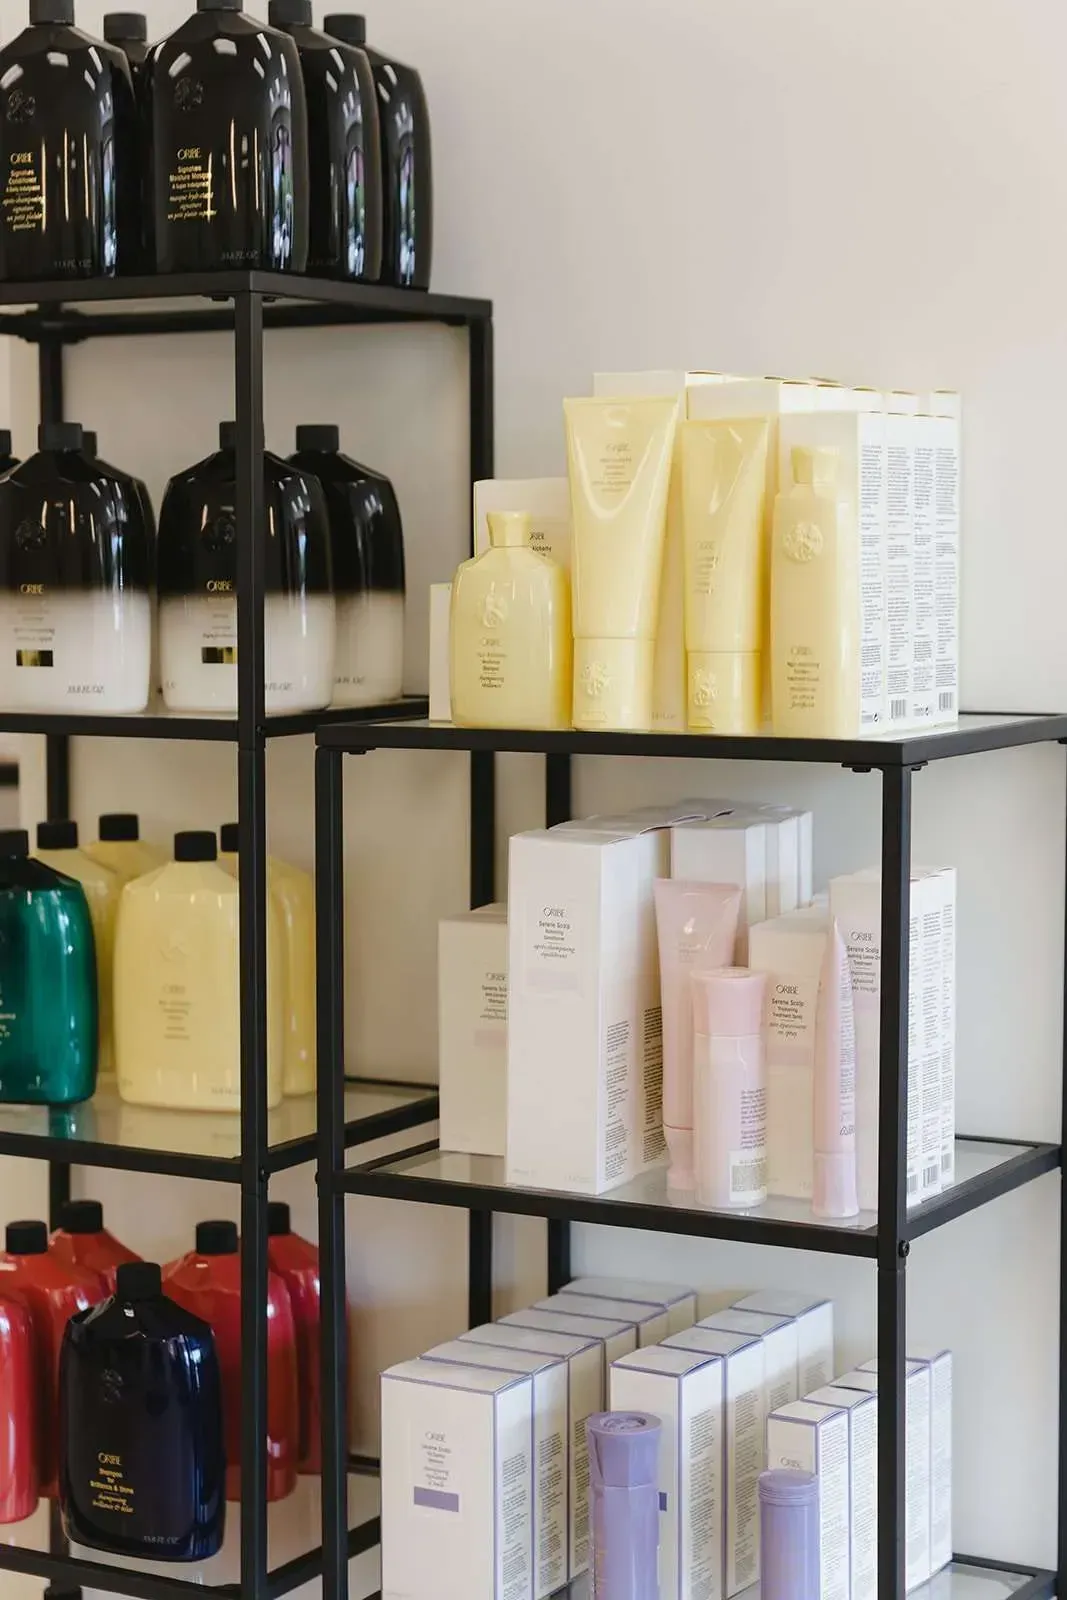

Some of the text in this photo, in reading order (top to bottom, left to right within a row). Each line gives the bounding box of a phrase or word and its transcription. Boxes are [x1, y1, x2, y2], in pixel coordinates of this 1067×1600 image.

[177, 148, 201, 160] ORIBE
[20, 583, 45, 594] ORIBE
[206, 580, 232, 591] ORIBE
[543, 906, 566, 917] ORIBE
[775, 984, 799, 995] ORIBE
